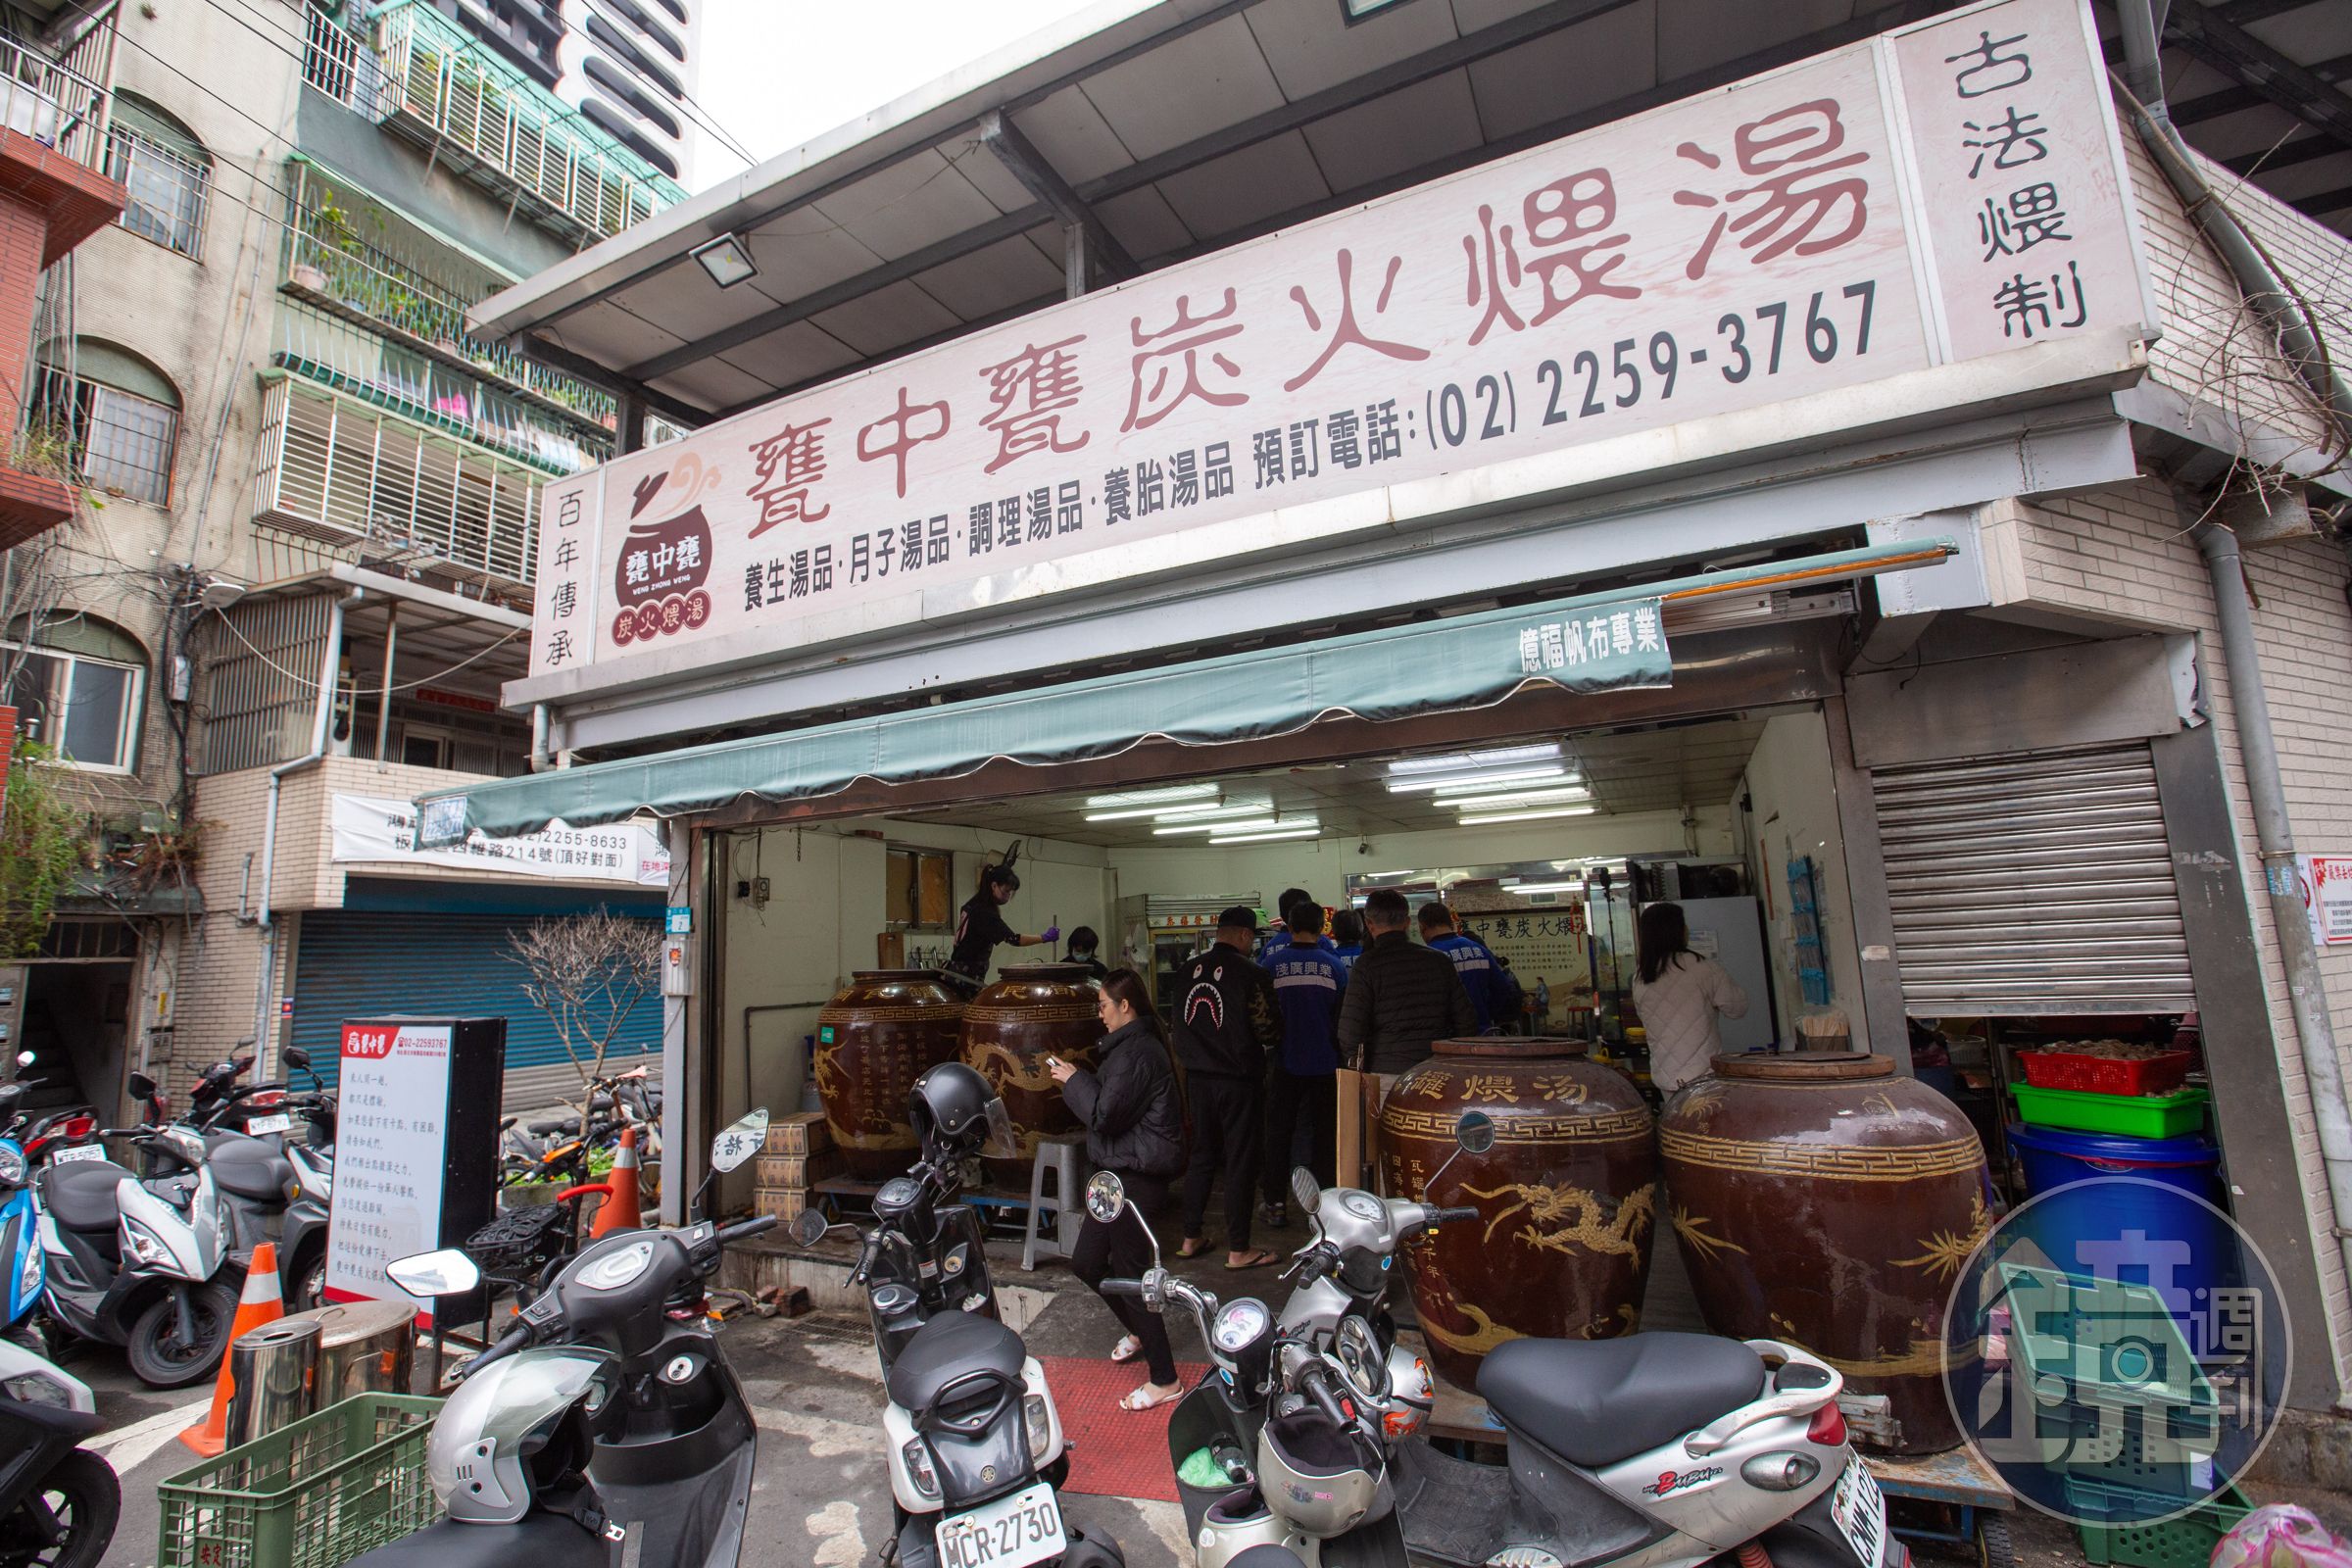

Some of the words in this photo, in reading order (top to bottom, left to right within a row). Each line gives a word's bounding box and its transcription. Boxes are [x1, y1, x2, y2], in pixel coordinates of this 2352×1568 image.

[1944, 31, 2086, 338] 古法煨制
[746, 98, 1871, 540] 甕中甕炭火煨湯
[1536, 280, 1877, 427] 2259-3767
[546, 490, 584, 665] 百年傳承
[616, 597, 704, 639] 炭火煨湯
[625, 535, 701, 585] 甕中甕
